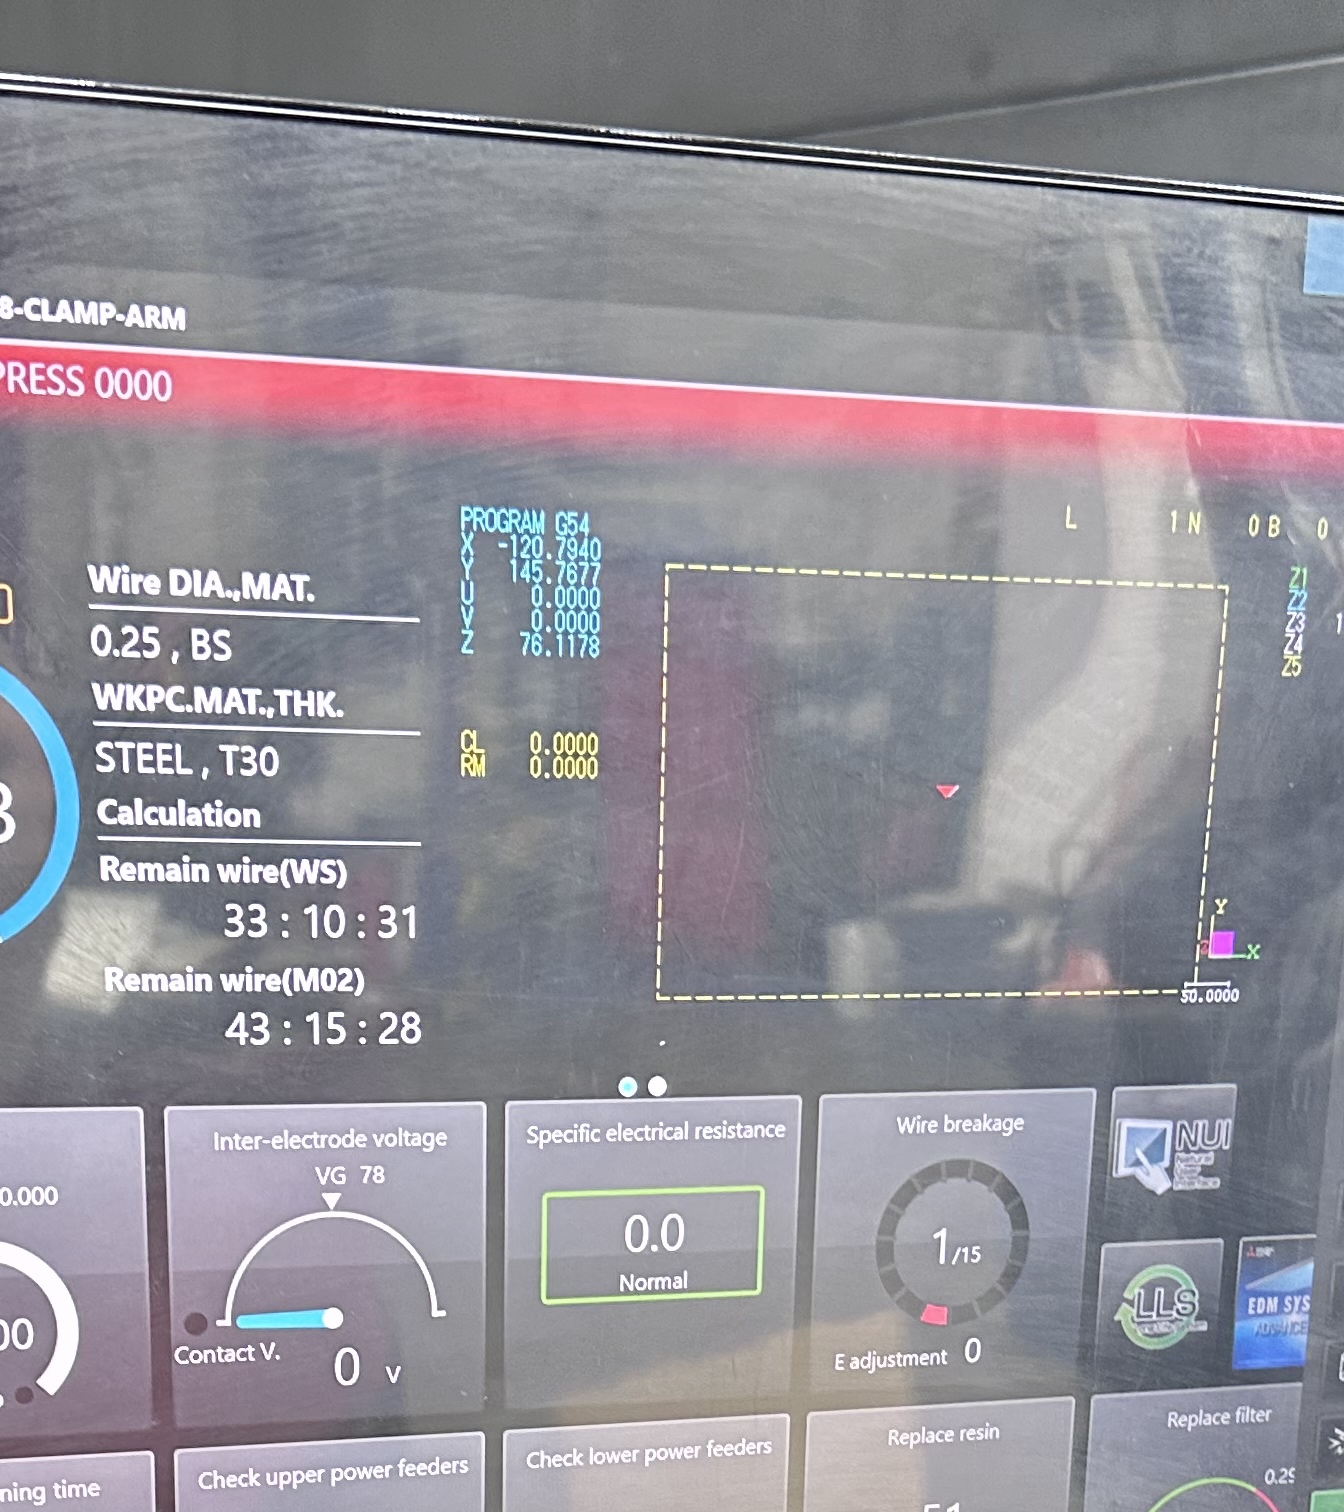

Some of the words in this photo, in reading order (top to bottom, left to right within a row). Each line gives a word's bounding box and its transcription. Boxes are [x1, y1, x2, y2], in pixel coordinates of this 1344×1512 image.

[95, 368, 172, 403] 0000
[460, 506, 545, 535] PROGRAM
[556, 511, 589, 536] G54
[498, 535, 602, 561] -120.7940
[88, 565, 161, 597] Wire
[510, 559, 601, 585] 145.7677
[531, 584, 601, 609] 0.0000
[531, 609, 600, 633] 0.0000
[90, 625, 161, 659] 0.25
[192, 629, 233, 660] BS
[520, 631, 600, 658] 76.1178
[460, 729, 485, 753] CL
[530, 731, 599, 756] 0.0000
[95, 742, 194, 776] STEEL
[220, 746, 279, 777] T30
[460, 753, 486, 778] RM
[530, 756, 599, 780] 0.0000
[96, 800, 261, 829] Calculation
[100, 855, 209, 885] Remain
[217, 857, 347, 889] wire(WS)
[224, 903, 268, 938] 33
[305, 903, 346, 938] 10
[378, 903, 418, 939] 31
[104, 967, 212, 994] Remain
[220, 965, 365, 996] wire(M02)
[225, 1013, 271, 1045] 43
[306, 1012, 346, 1044] 15
[378, 1011, 422, 1044] 28
[526, 1122, 601, 1149] Specific
[606, 1121, 690, 1144] electrical
[693, 1118, 786, 1143] resistance
[897, 1114, 938, 1135] Wire
[943, 1112, 1025, 1140] breakage
[1175, 1119, 1232, 1151] NUI
[213, 1130, 368, 1152] Inter-electrode
[372, 1128, 447, 1154] voltage
[315, 1167, 347, 1186] VG
[360, 1166, 386, 1185] 78
[623, 1213, 685, 1253] 0.0
[619, 1270, 689, 1293] Normal
[1134, 1288, 1199, 1322] LLS
[1248, 1297, 1278, 1315] EDM
[174, 1344, 255, 1366] Contact
[259, 1343, 281, 1362] V.
[334, 1348, 361, 1386] 0
[849, 1347, 948, 1374] adjustment
[1168, 1410, 1231, 1431] Replace
[1235, 1406, 1272, 1424] filter
[888, 1425, 954, 1451] Replace
[959, 1421, 1000, 1443] resin
[526, 1448, 584, 1470] Check
[588, 1445, 640, 1467] lower
[644, 1443, 701, 1468] power
[705, 1436, 773, 1458] feeders
[53, 1477, 101, 1500] time
[198, 1467, 260, 1491] Check
[264, 1467, 326, 1493] upper
[331, 1463, 393, 1487] power
[397, 1456, 469, 1479] feeders
